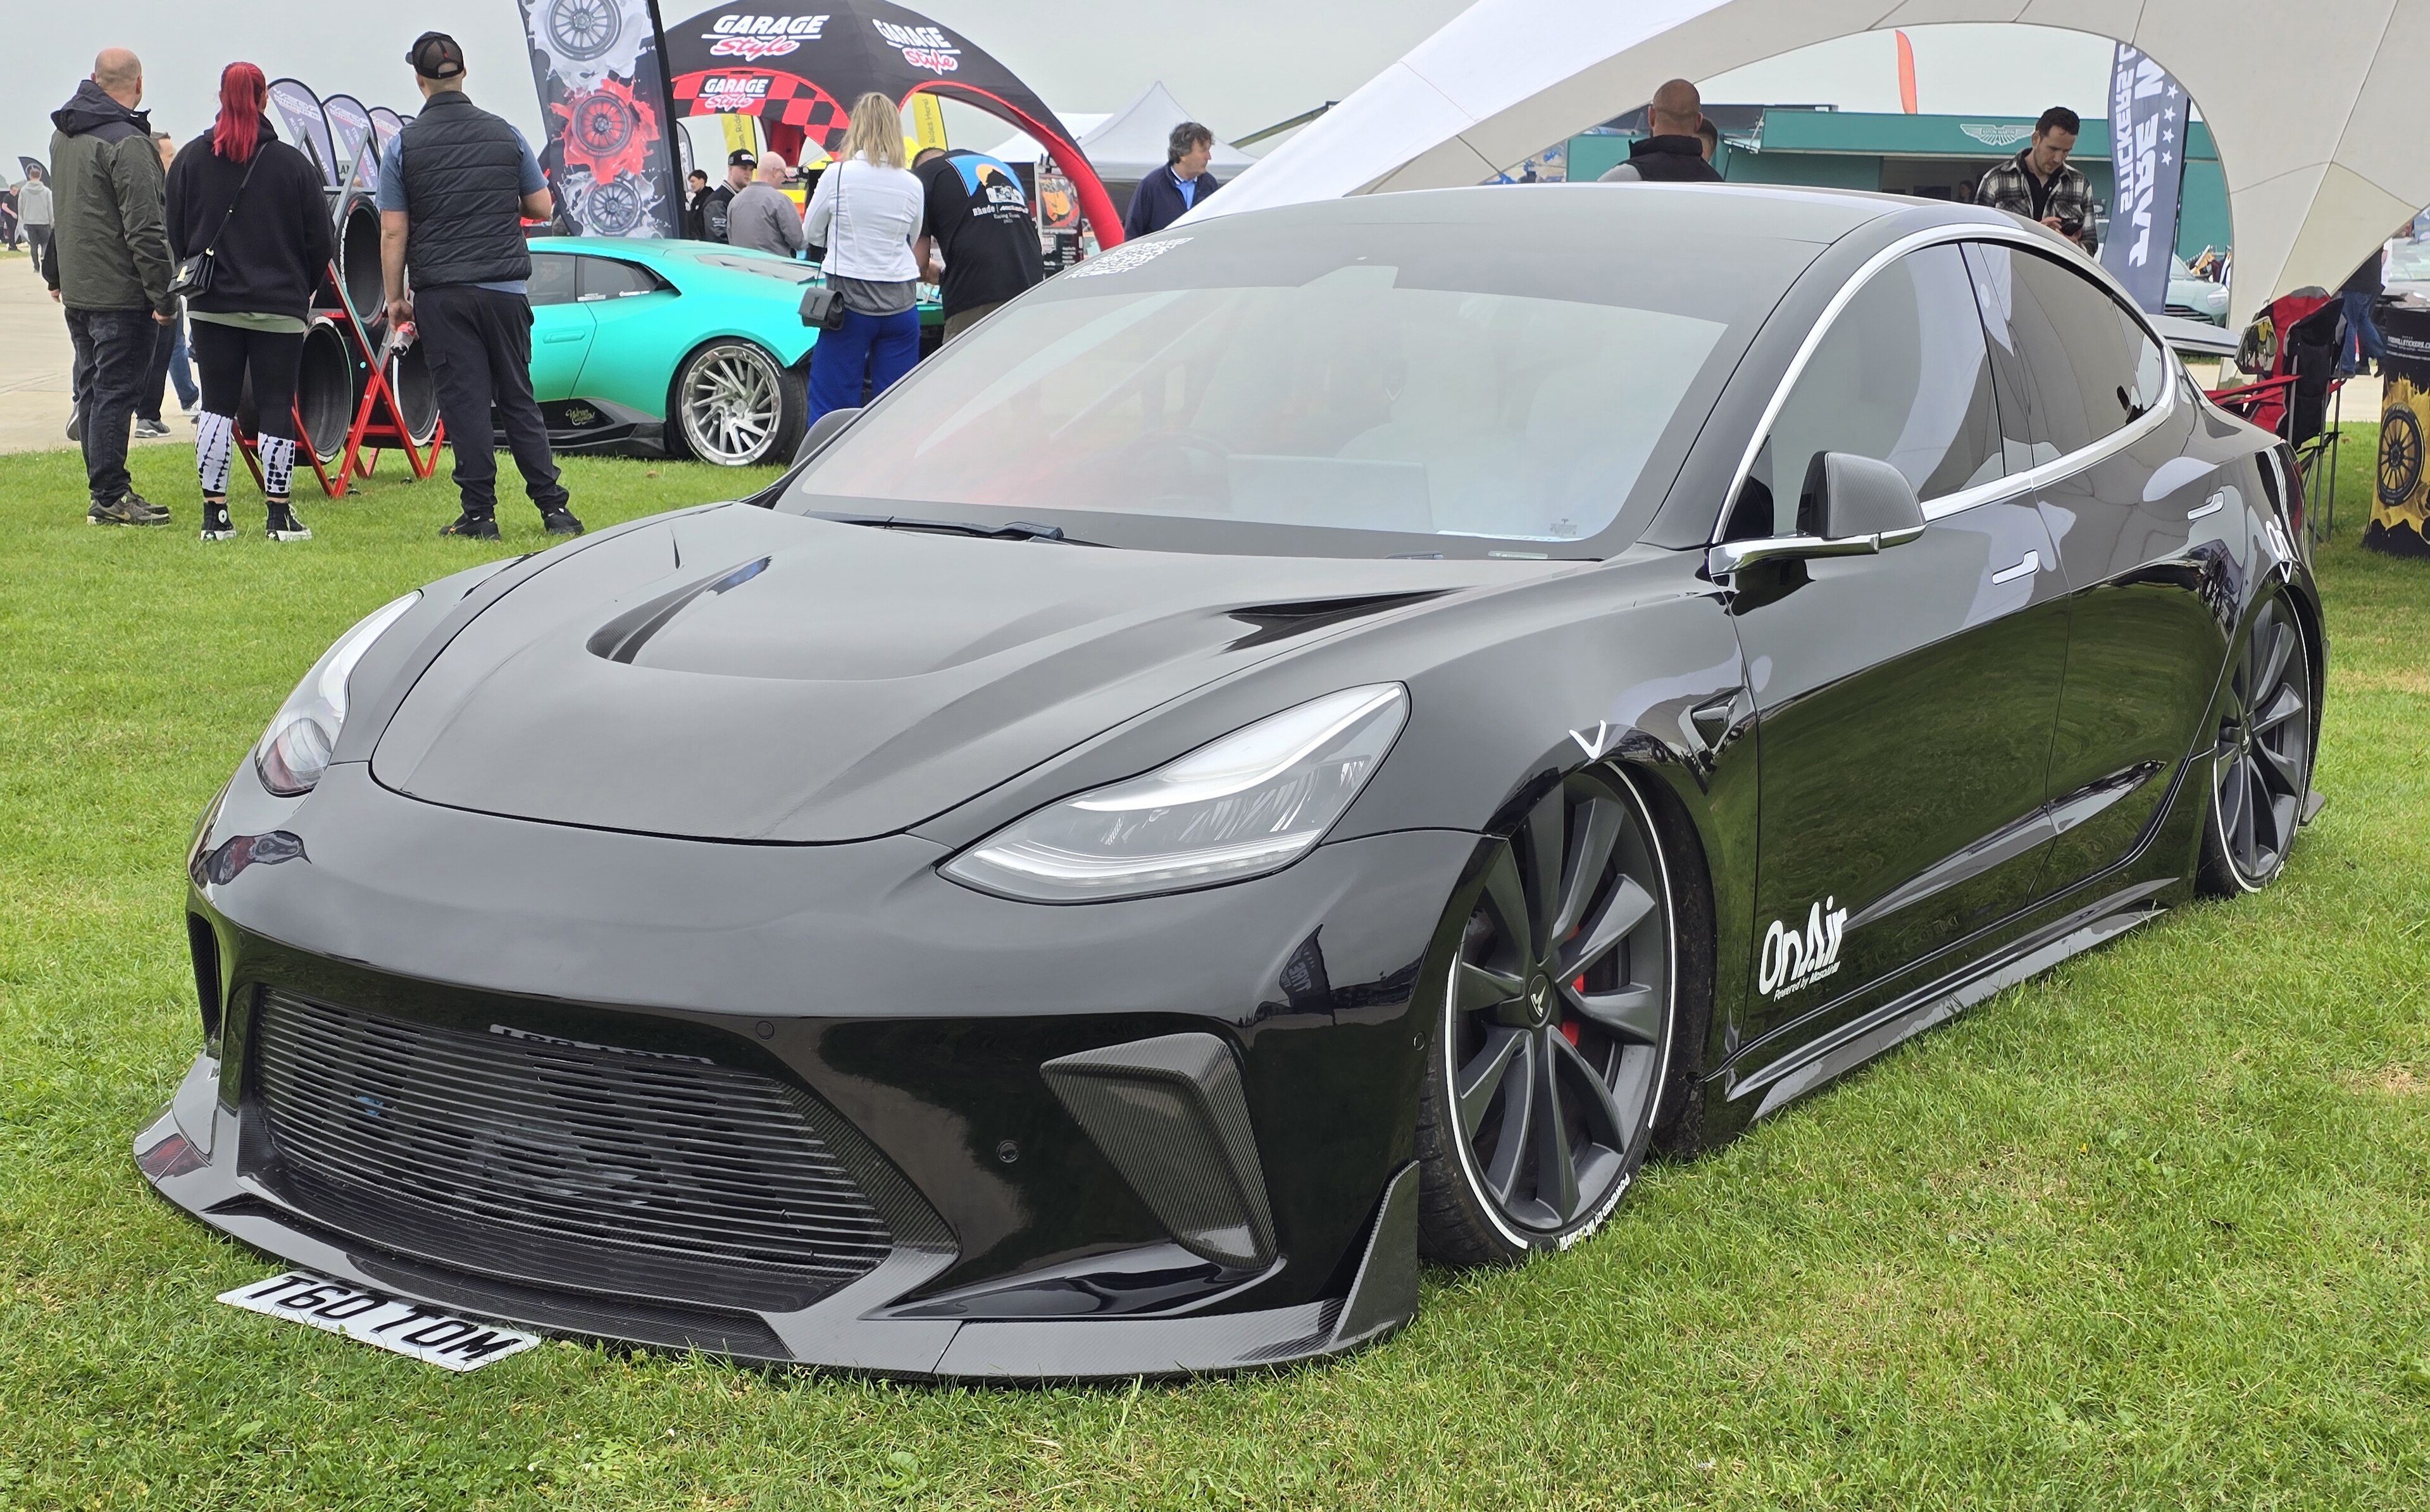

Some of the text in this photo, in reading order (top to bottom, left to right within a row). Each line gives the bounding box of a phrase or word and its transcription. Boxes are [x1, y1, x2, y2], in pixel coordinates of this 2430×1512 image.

[713, 15, 830, 34] GARAGE
[873, 19, 952, 47] GARAGE
[710, 35, 800, 61] Style
[902, 47, 958, 75] Style
[704, 78, 768, 93] GARAGE
[705, 94, 754, 111] Style
[1800, 976, 1810, 990] by
[1602, 1172, 1631, 1217] POWERED
[370, 1304, 523, 1361] TOM
